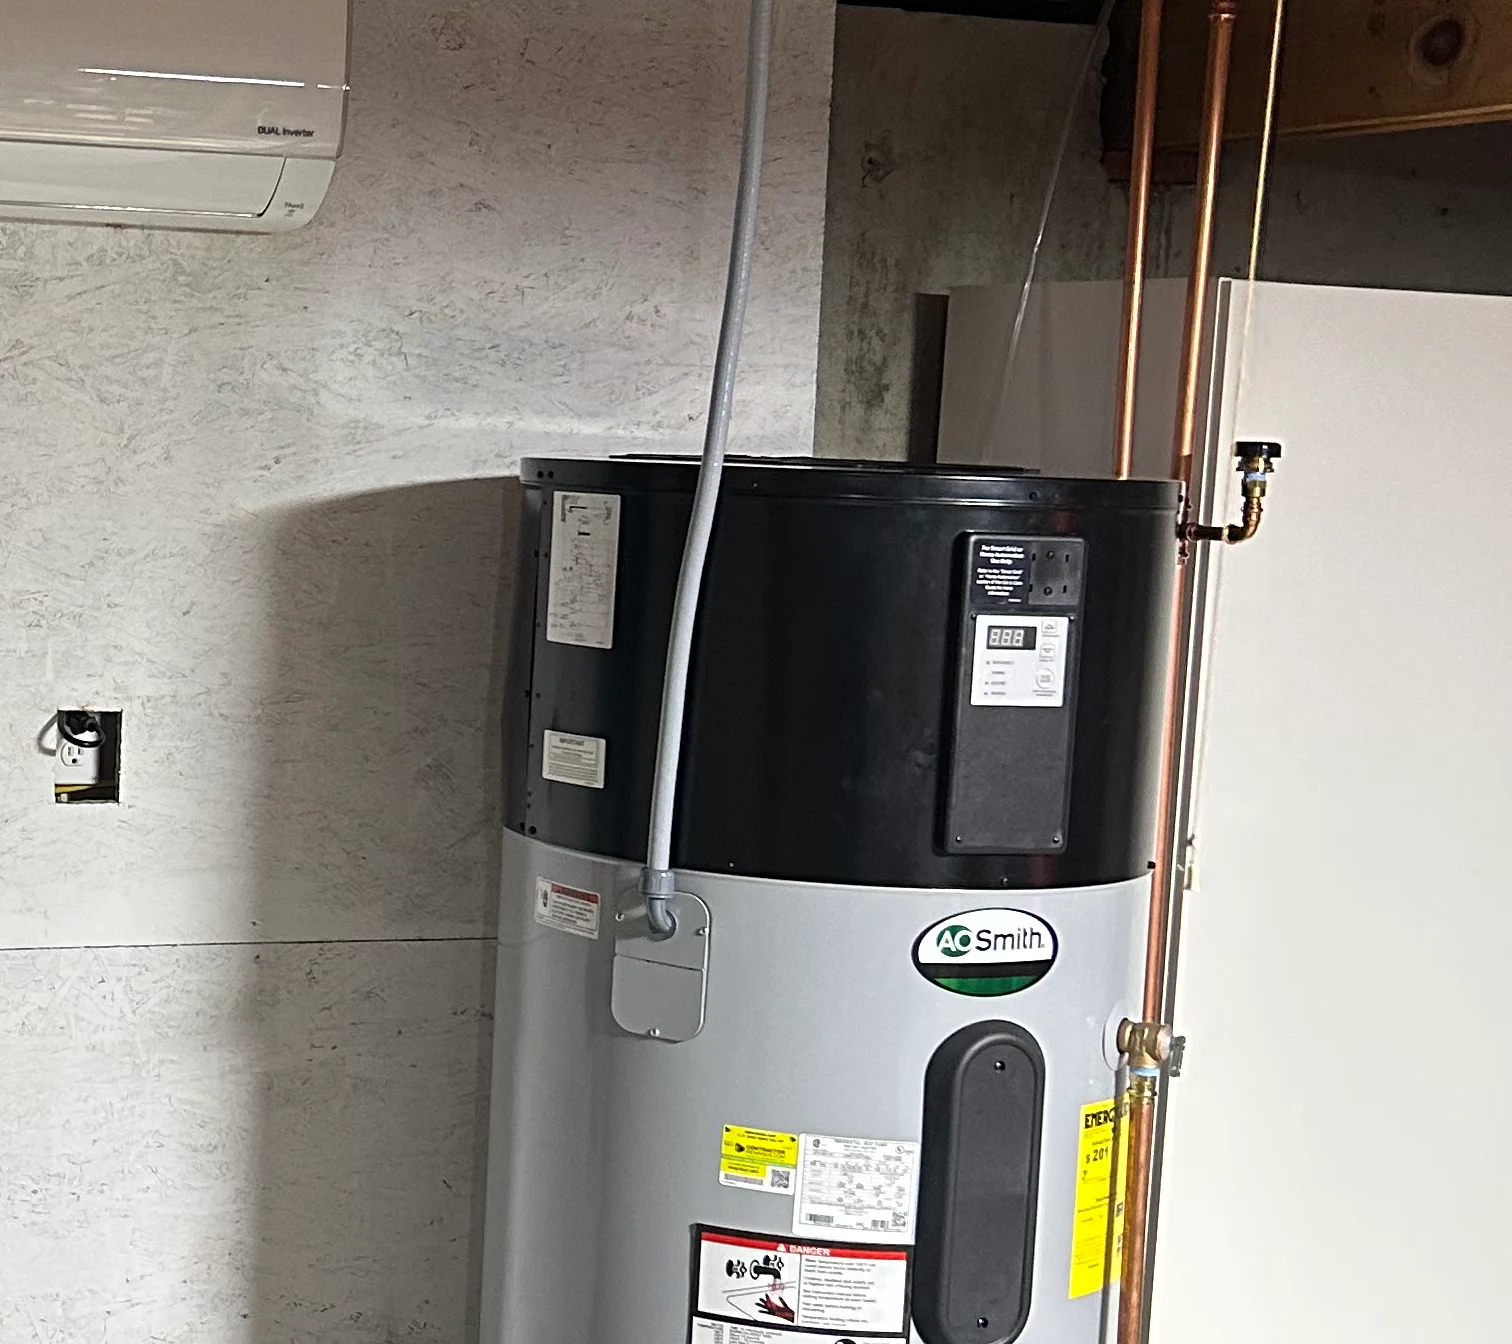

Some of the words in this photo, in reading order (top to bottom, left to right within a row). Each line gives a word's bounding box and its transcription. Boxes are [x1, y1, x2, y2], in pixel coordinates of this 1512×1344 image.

[257, 125, 281, 136] DUAL
[283, 127, 315, 137] Inverter
[789, 1244, 831, 1256] DANGER
